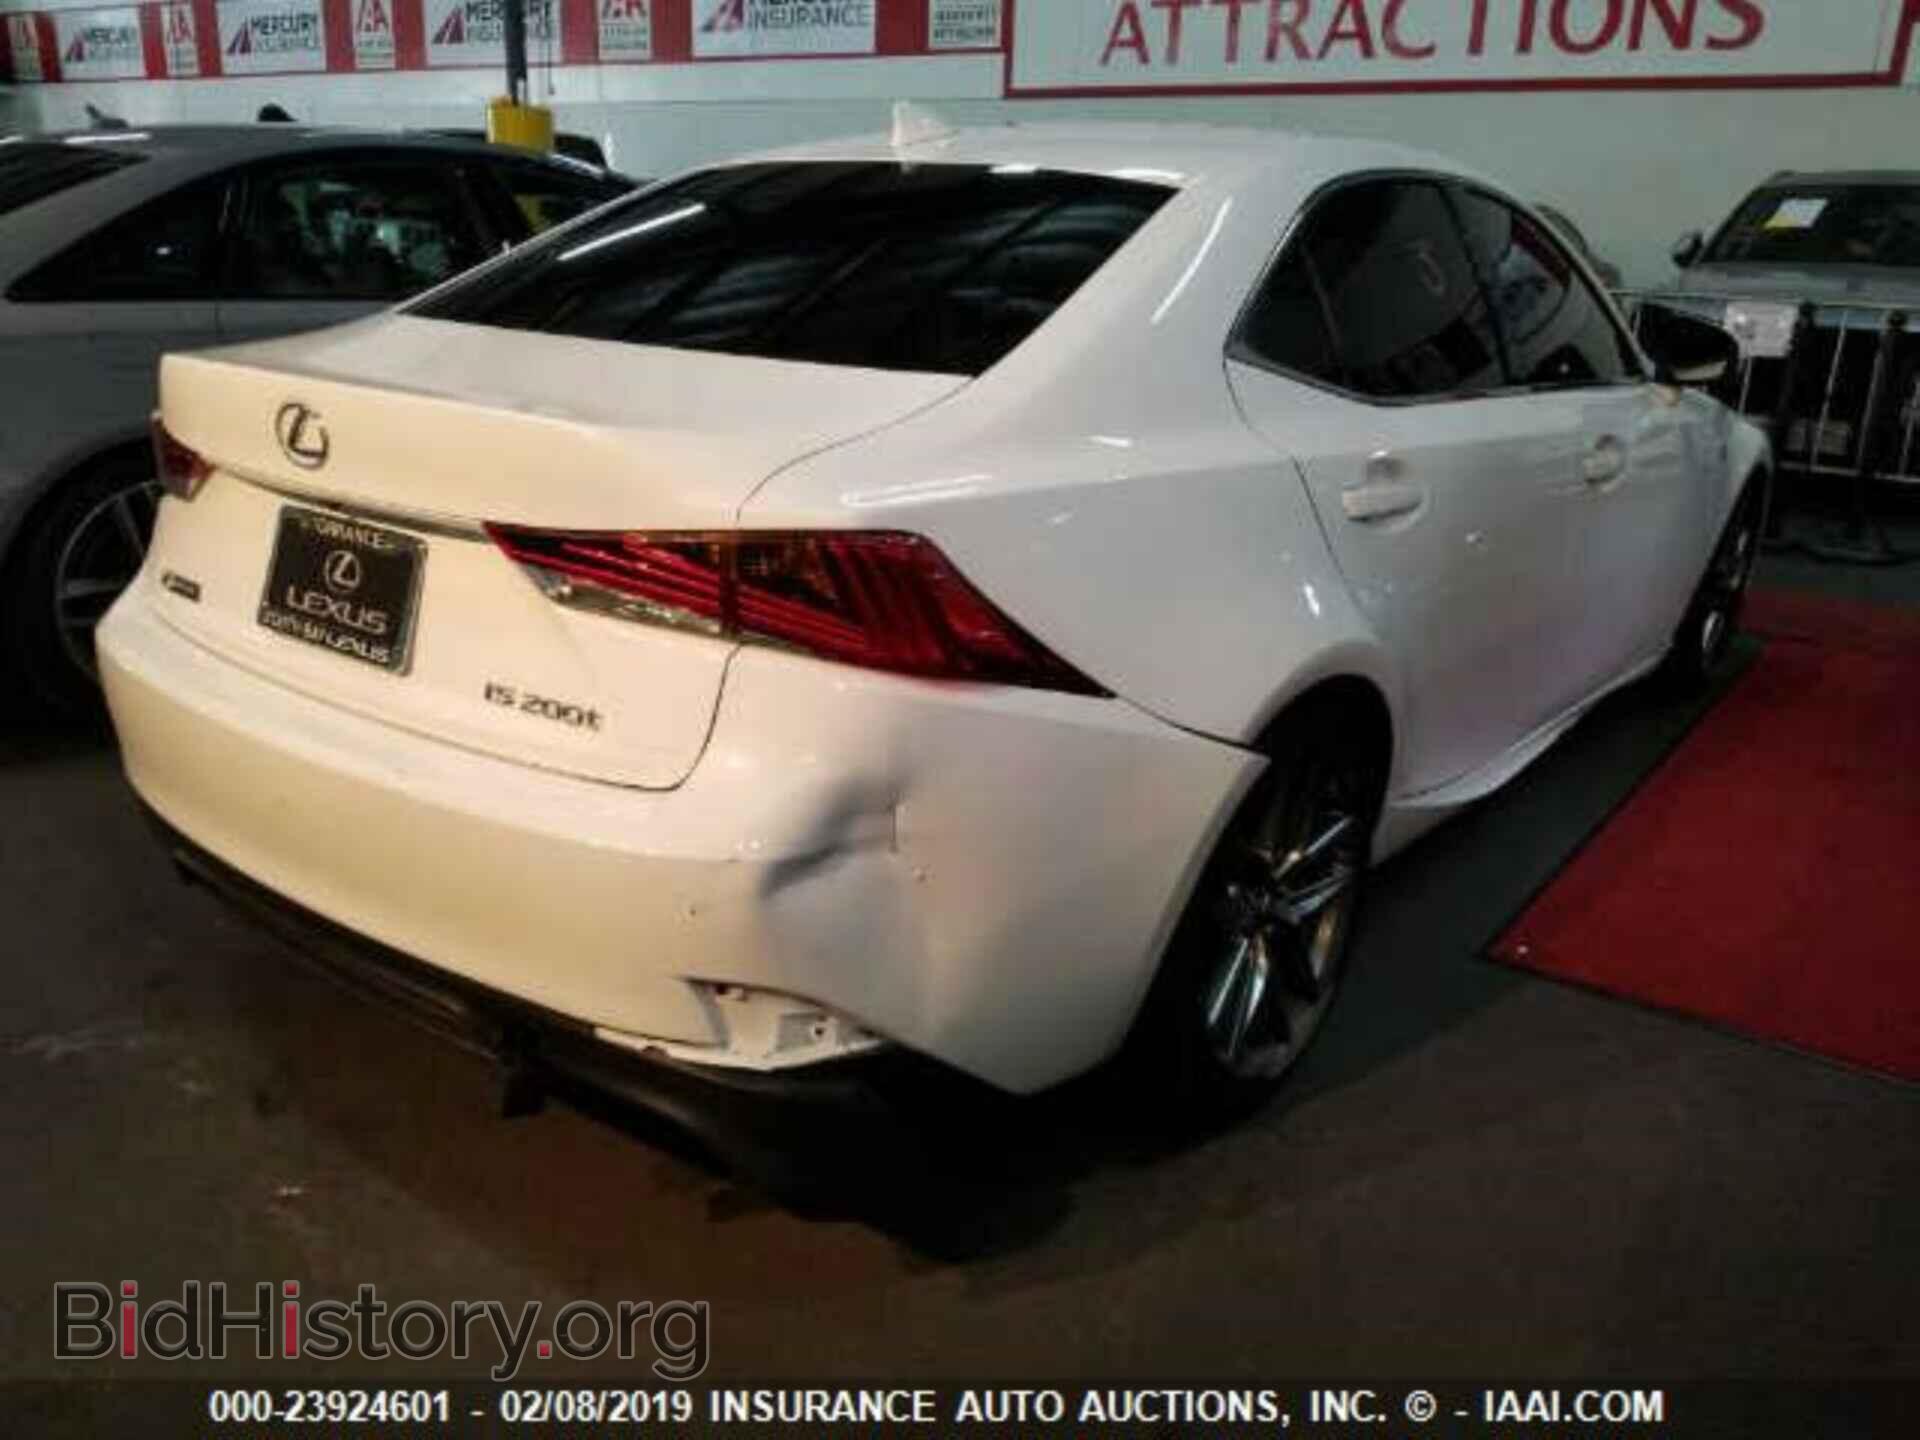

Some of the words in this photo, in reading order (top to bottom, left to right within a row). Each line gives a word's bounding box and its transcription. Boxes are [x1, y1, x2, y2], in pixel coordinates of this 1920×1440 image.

[286, 584, 388, 634] LEXUS
[484, 681, 516, 705] IS
[520, 692, 603, 733] 200t
